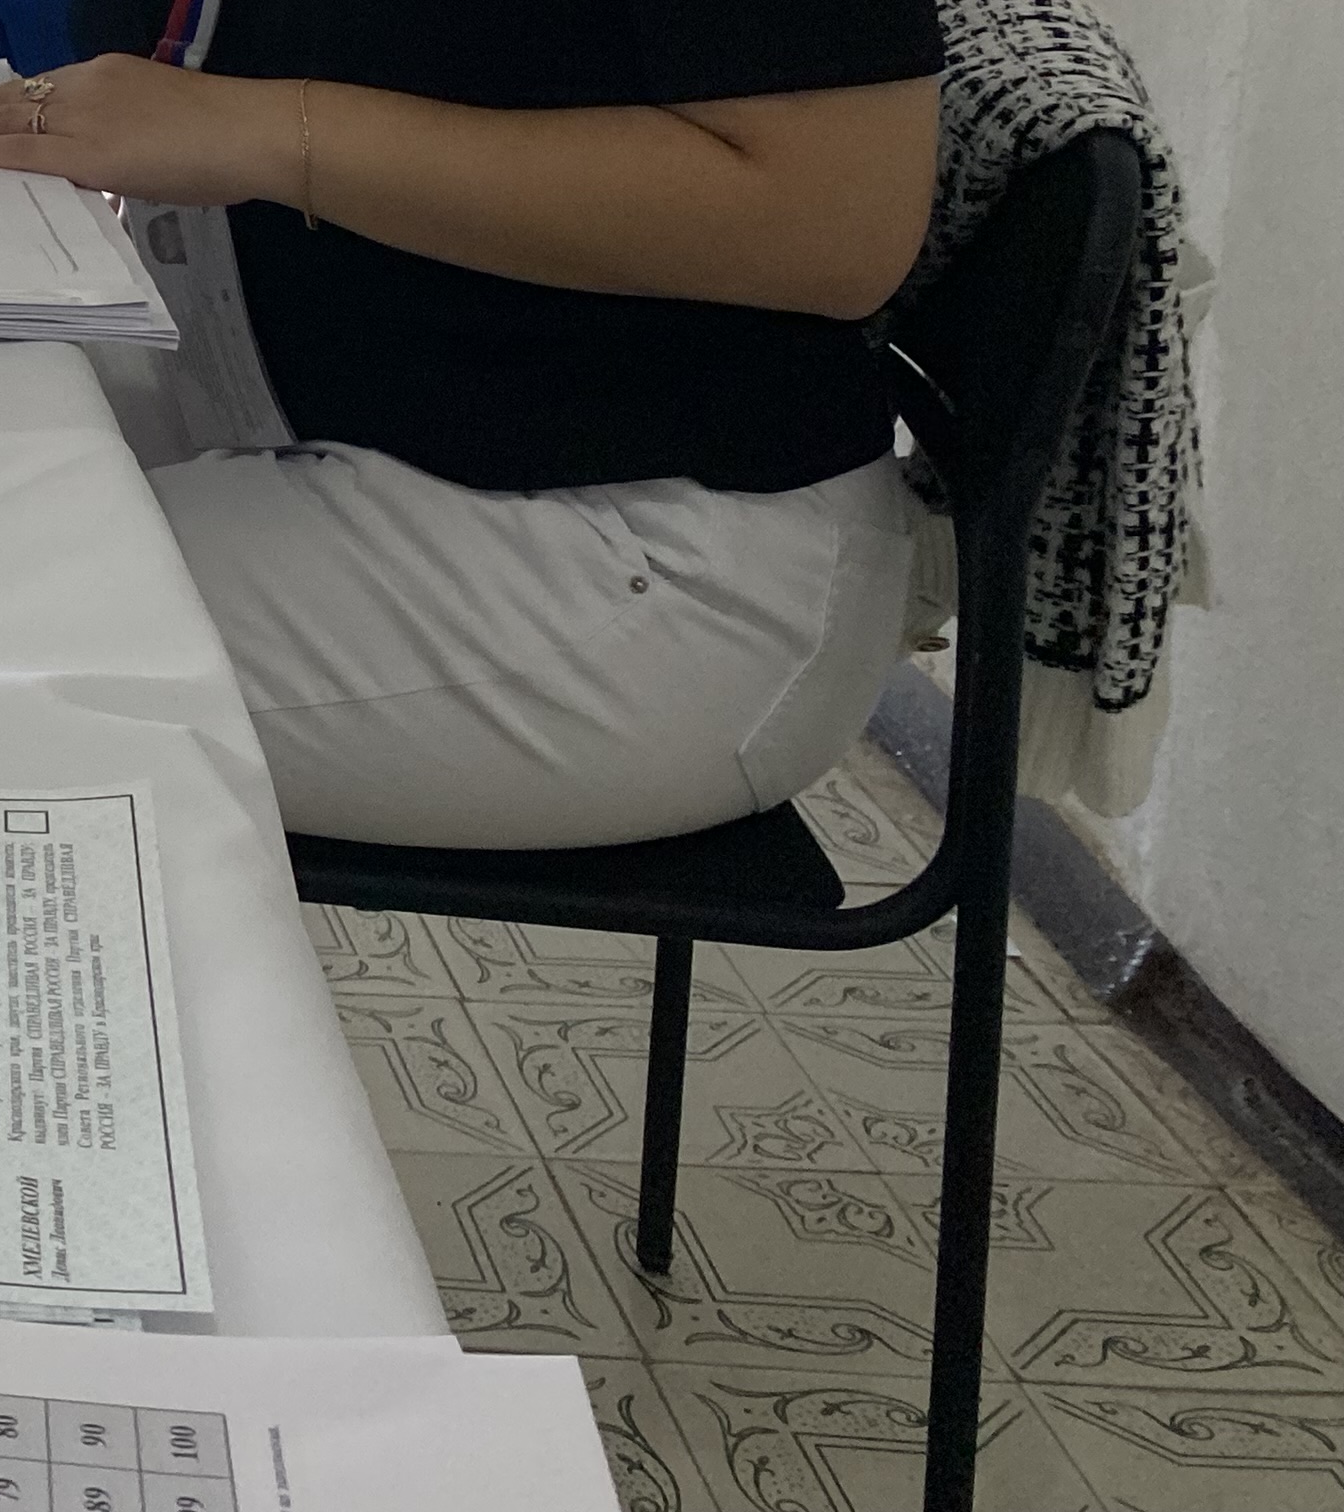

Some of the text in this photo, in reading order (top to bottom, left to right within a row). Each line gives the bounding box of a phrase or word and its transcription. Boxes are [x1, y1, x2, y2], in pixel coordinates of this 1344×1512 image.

[59, 843, 78, 923] СПРАВЕДЛИВАЯ
[22, 916, 39, 955] РОССИЯ
[23, 961, 41, 1039] СПРАВЕДЛИВАЯ
[44, 956, 62, 996] РОССИЯ
[73, 1023, 90, 1100] Регионального
[92, 1030, 111, 1070] ПРАВДУ
[95, 1074, 113, 1088] ЗА
[7, 1062, 26, 1142] Краснодарского
[76, 1109, 93, 1148] Совета
[97, 1102, 117, 1150] РОССИЯ
[16, 1175, 42, 1279] ХМЕЛЕВСКОЙ
[50, 1178, 70, 1282] Денис Леонидович
[80, 1424, 111, 1512] 89 90
[171, 1425, 199, 1461] 100
